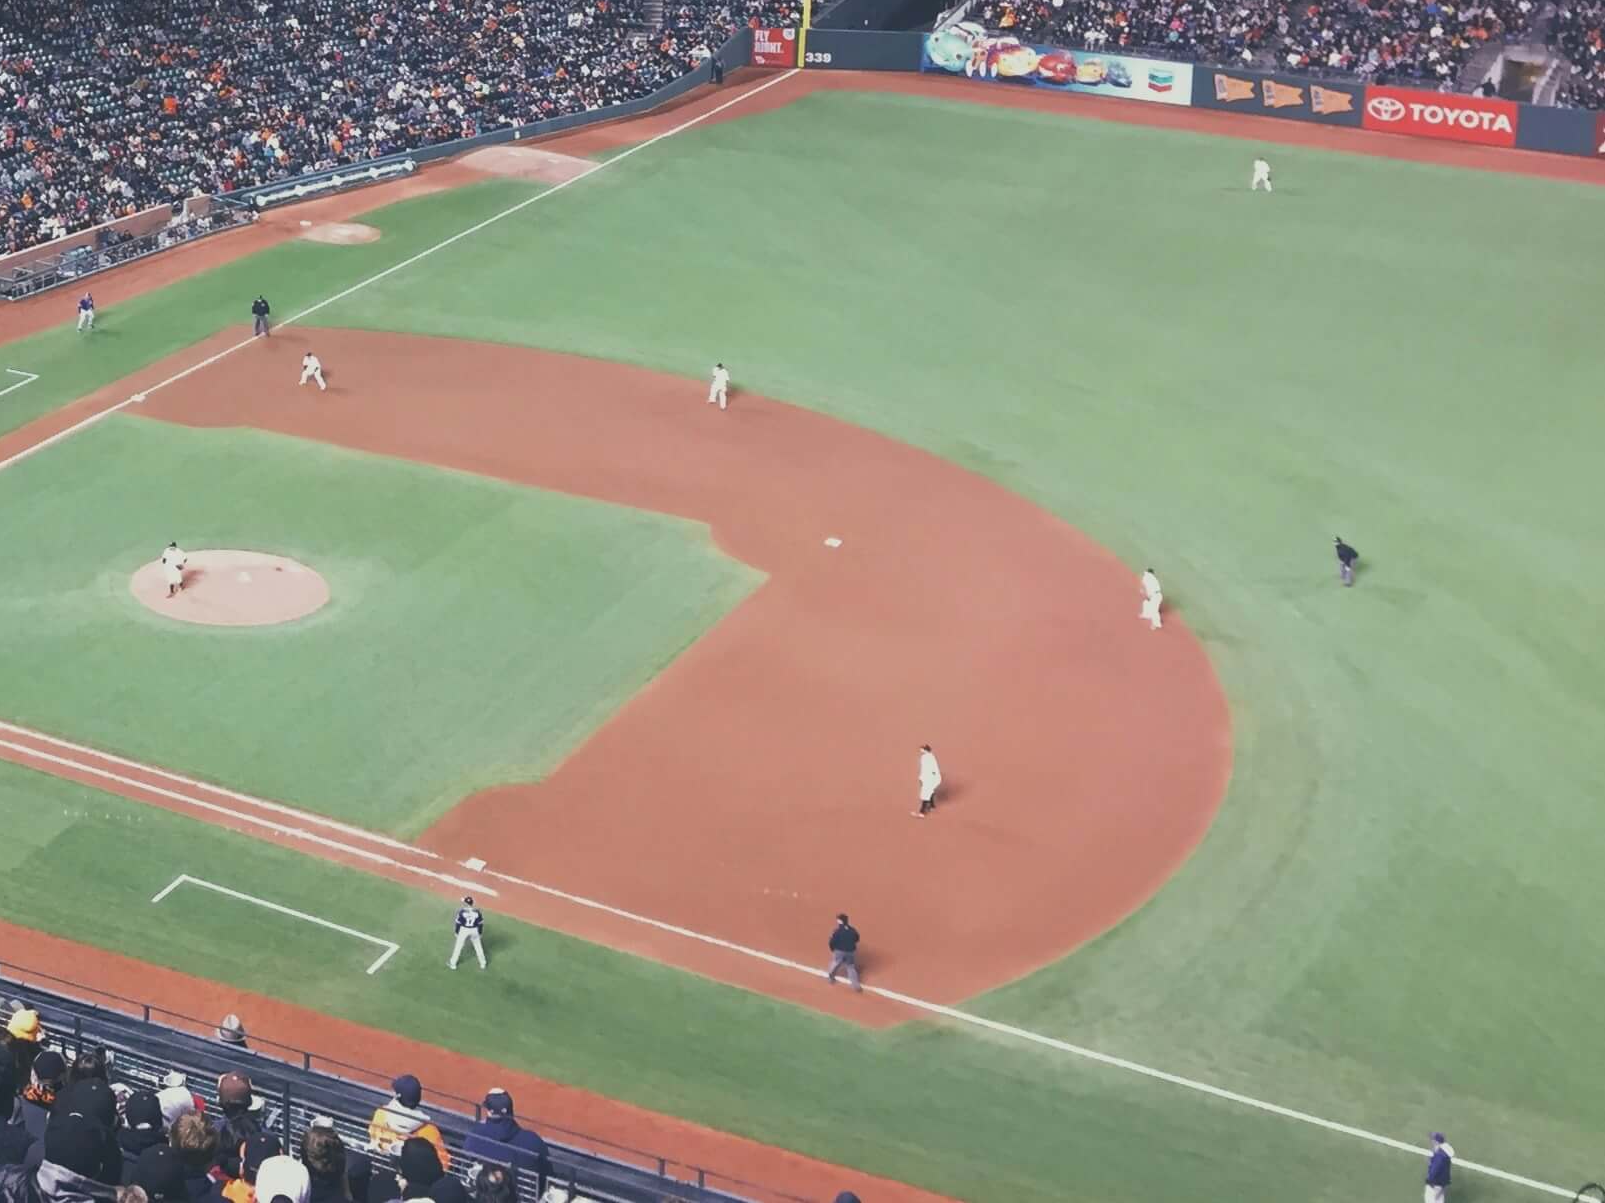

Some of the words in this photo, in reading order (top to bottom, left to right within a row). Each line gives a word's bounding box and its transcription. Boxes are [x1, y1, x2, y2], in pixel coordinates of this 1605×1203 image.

[754, 30, 770, 42] FLY
[805, 52, 832, 63] 339
[1410, 102, 1513, 133] TOYOTA
